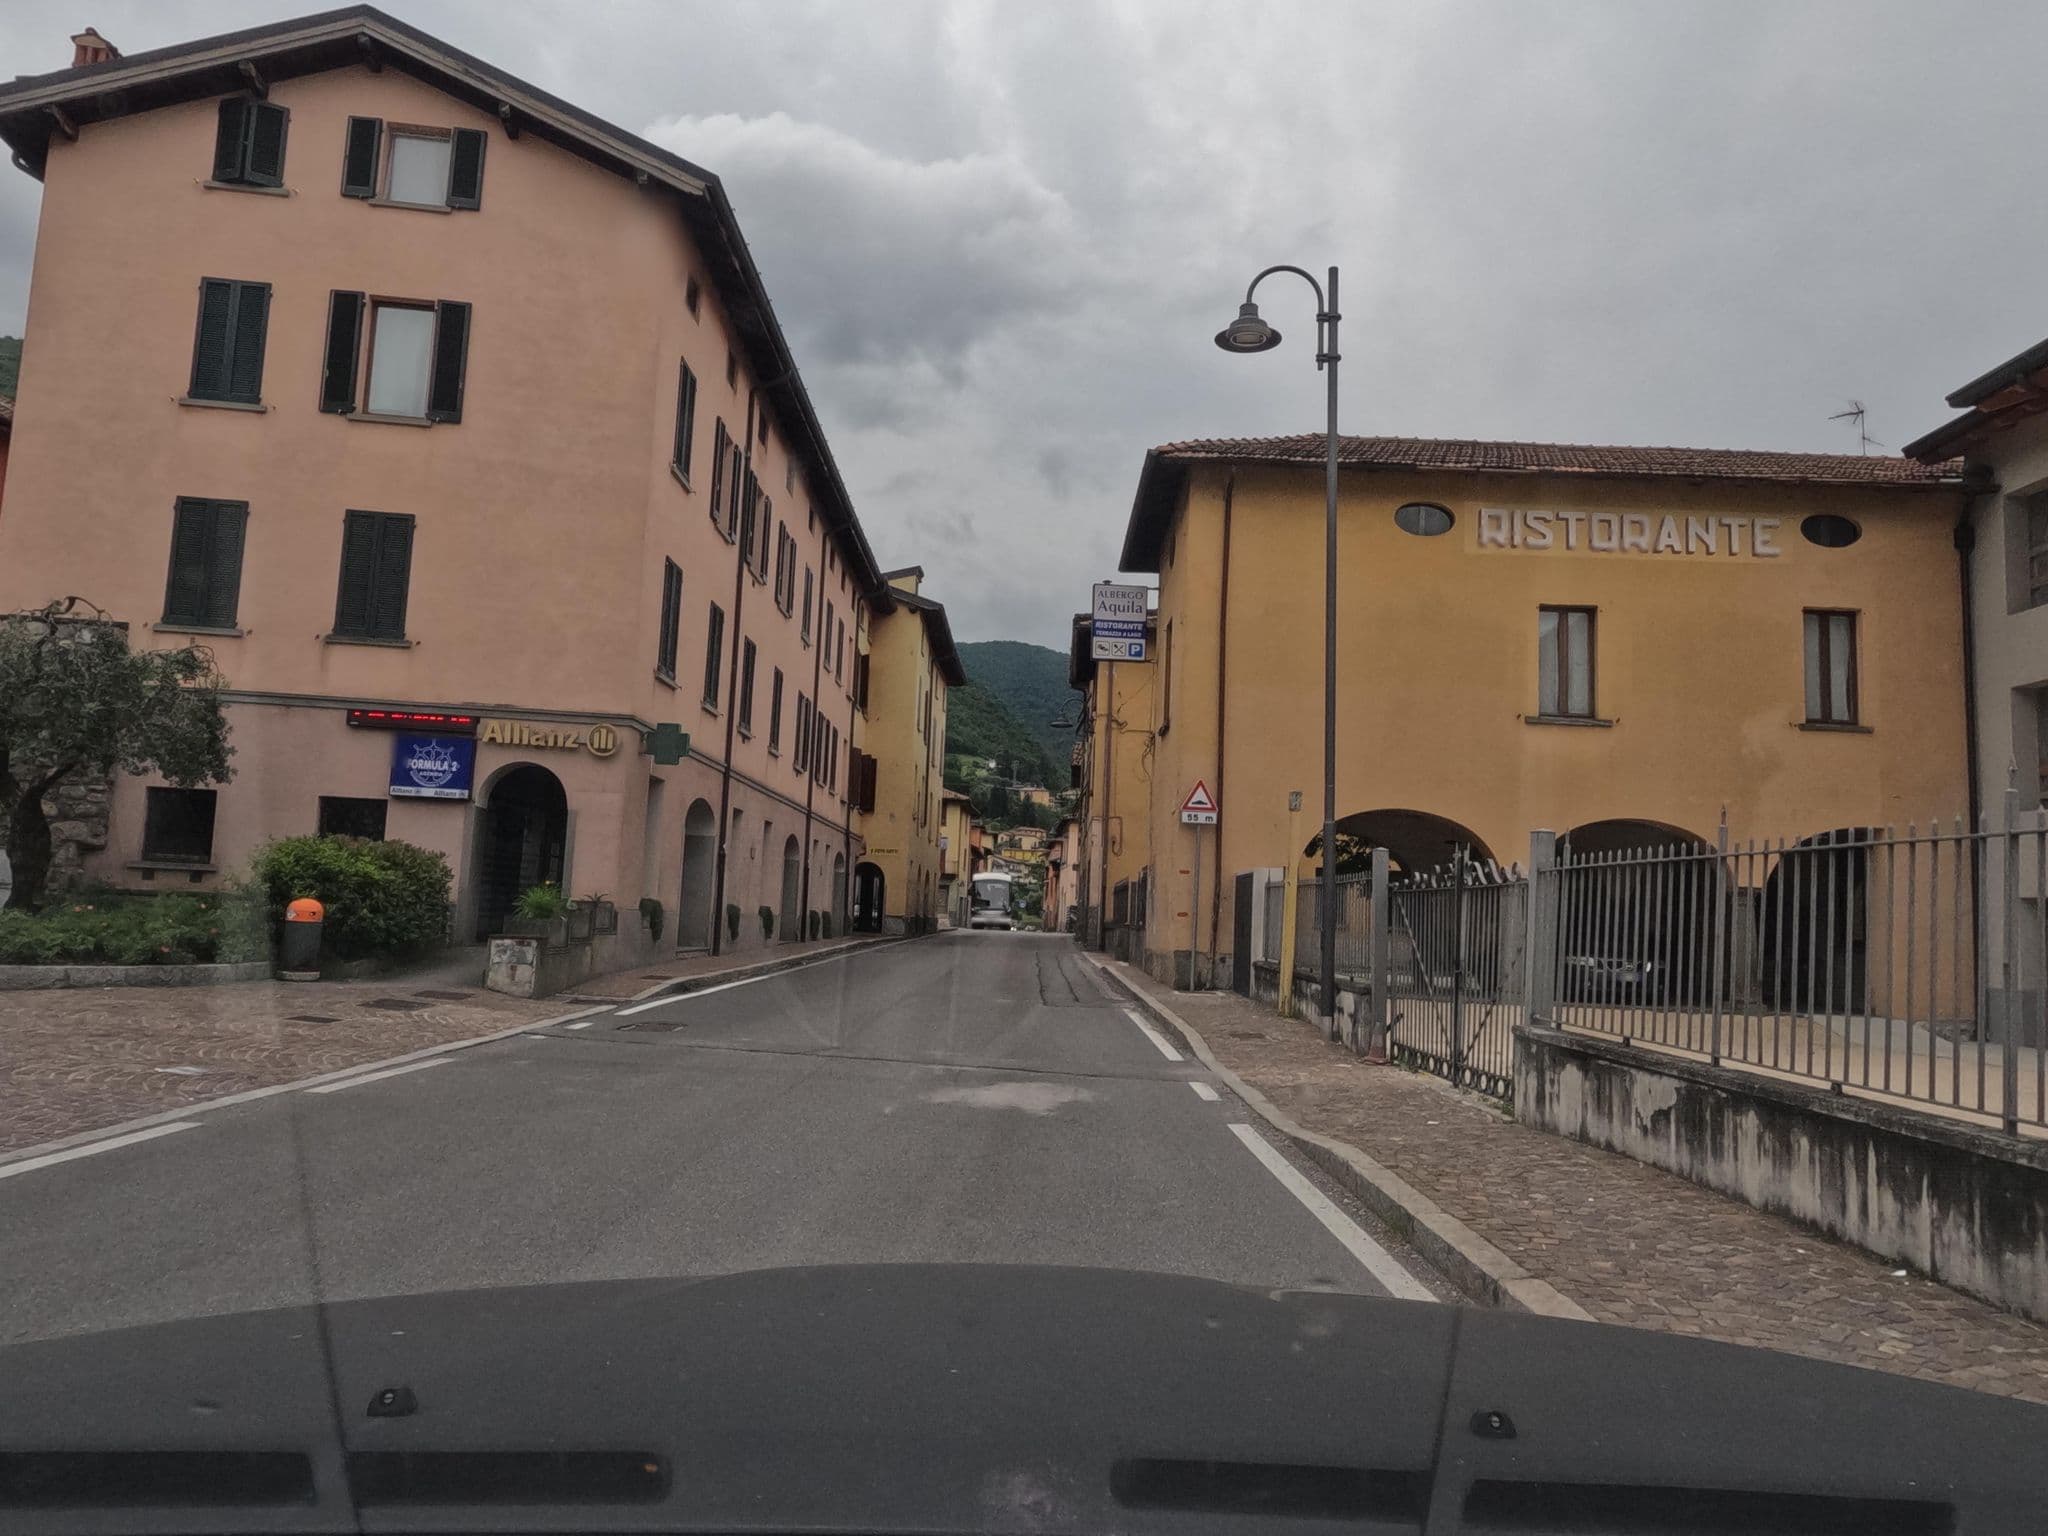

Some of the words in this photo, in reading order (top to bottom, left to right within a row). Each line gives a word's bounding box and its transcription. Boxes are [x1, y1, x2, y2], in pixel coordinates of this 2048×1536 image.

[1477, 506, 1782, 557] RISTORANTE
[1097, 590, 1144, 600] ALBERGO
[1097, 600, 1143, 616] Aquila
[1095, 621, 1144, 630] RISTORANTE
[481, 719, 580, 750] Allianz
[406, 758, 449, 771] FORMULA
